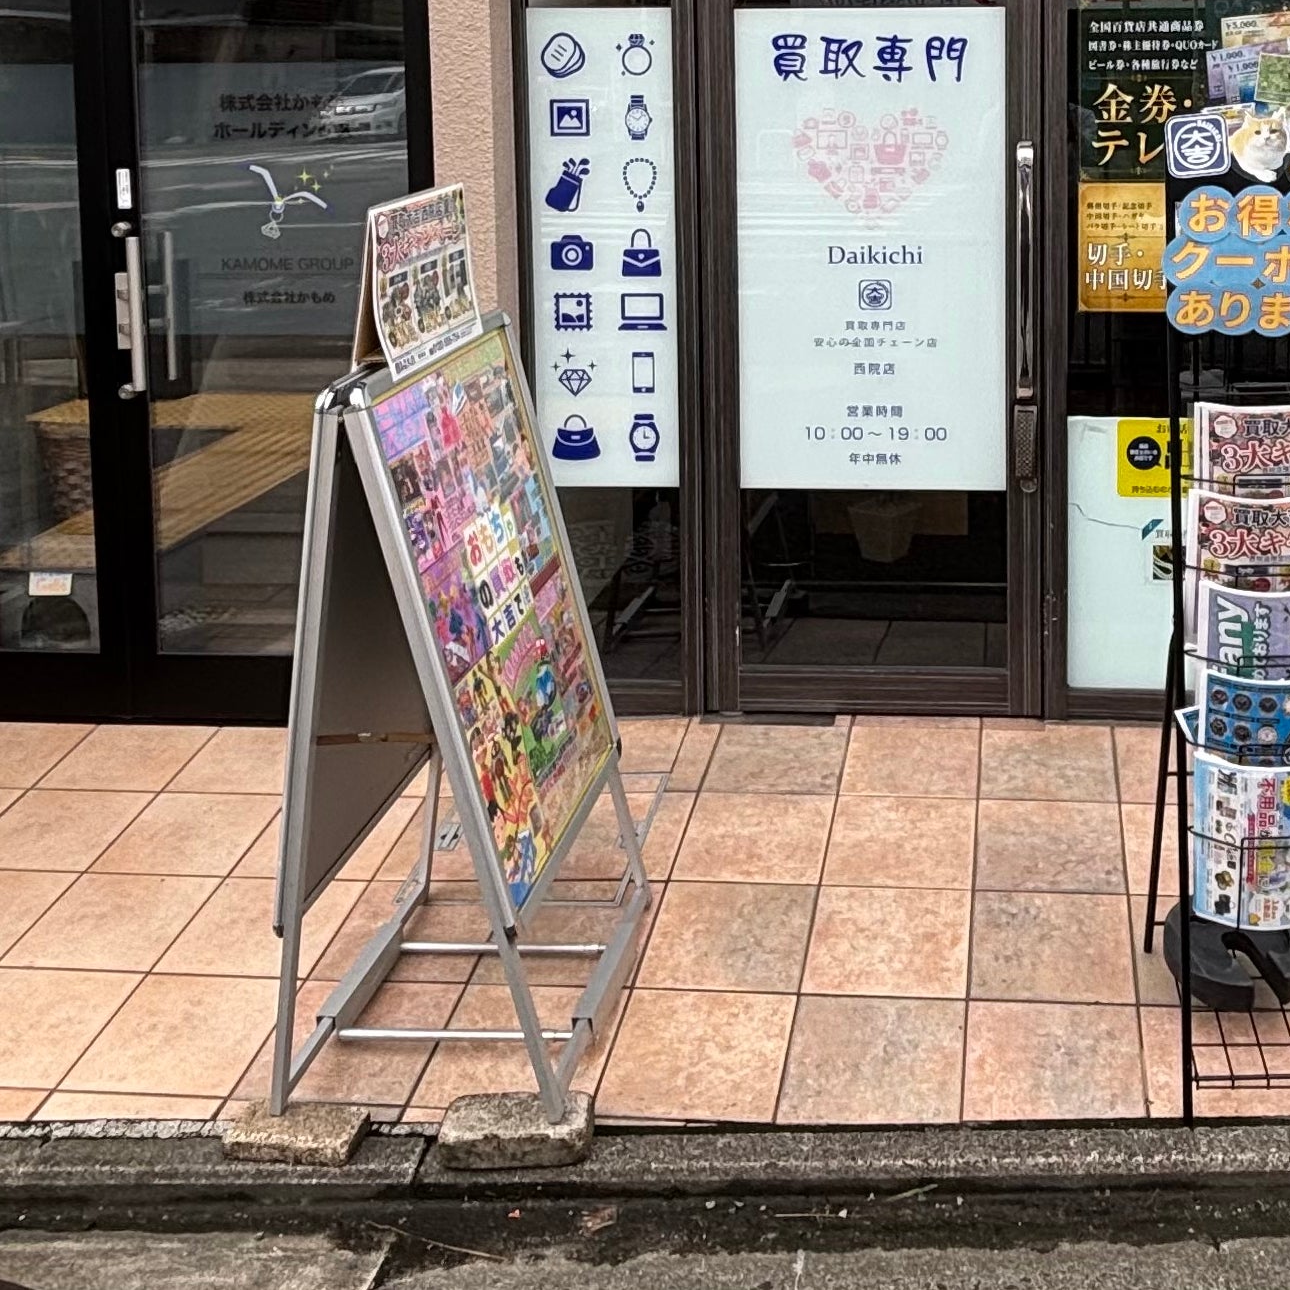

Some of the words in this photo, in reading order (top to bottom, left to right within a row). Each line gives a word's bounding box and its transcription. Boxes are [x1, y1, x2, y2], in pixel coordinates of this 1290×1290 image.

[771, 33, 968, 83] 買取専門
[827, 245, 923, 265] Daikichi
[221, 257, 293, 272] KAMOME
[297, 257, 355, 272] GROUP
[844, 320, 906, 331] 買取専門店
[853, 362, 895, 375] 西院店
[846, 405, 904, 418] 営業時間
[849, 453, 902, 466] 年中無休
